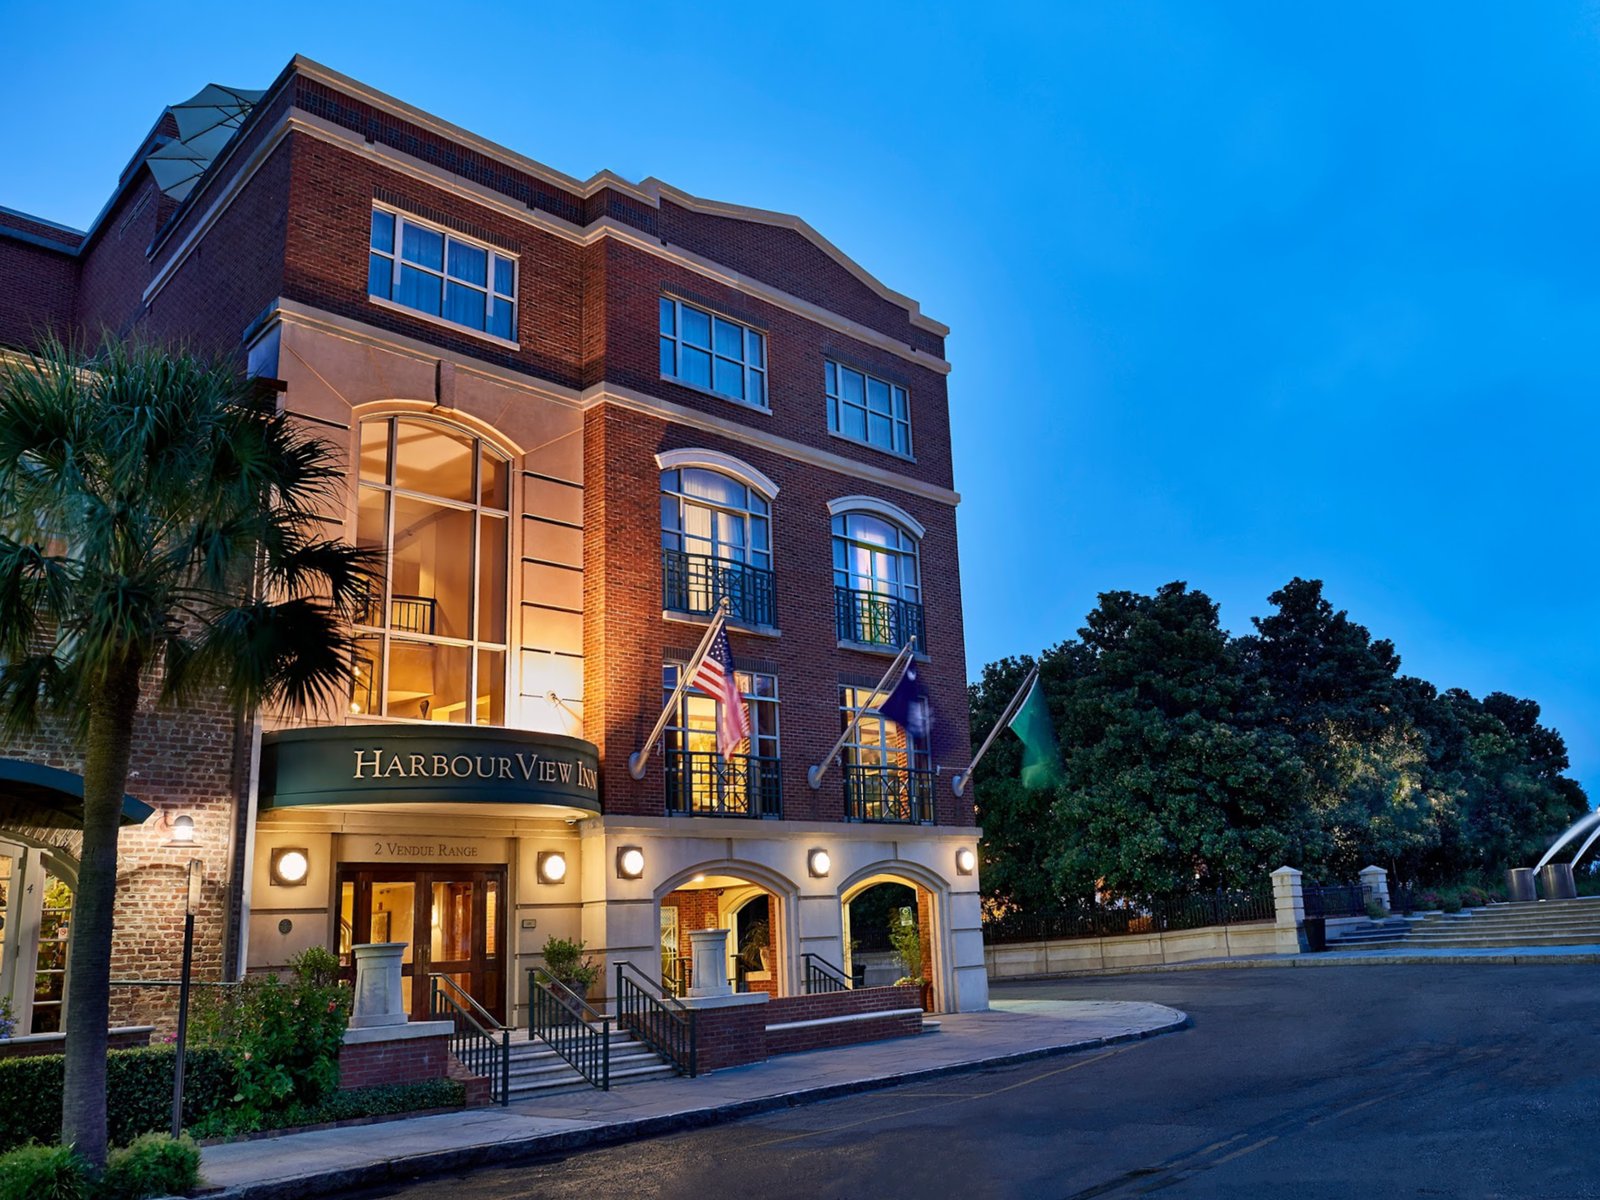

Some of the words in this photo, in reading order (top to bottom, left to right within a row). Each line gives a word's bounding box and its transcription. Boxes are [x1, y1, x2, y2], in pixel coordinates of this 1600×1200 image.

[577, 761, 598, 790] INN
[374, 842, 383, 856] 2
[387, 842, 435, 857] VENDUE
[438, 844, 478, 857] RANGE
